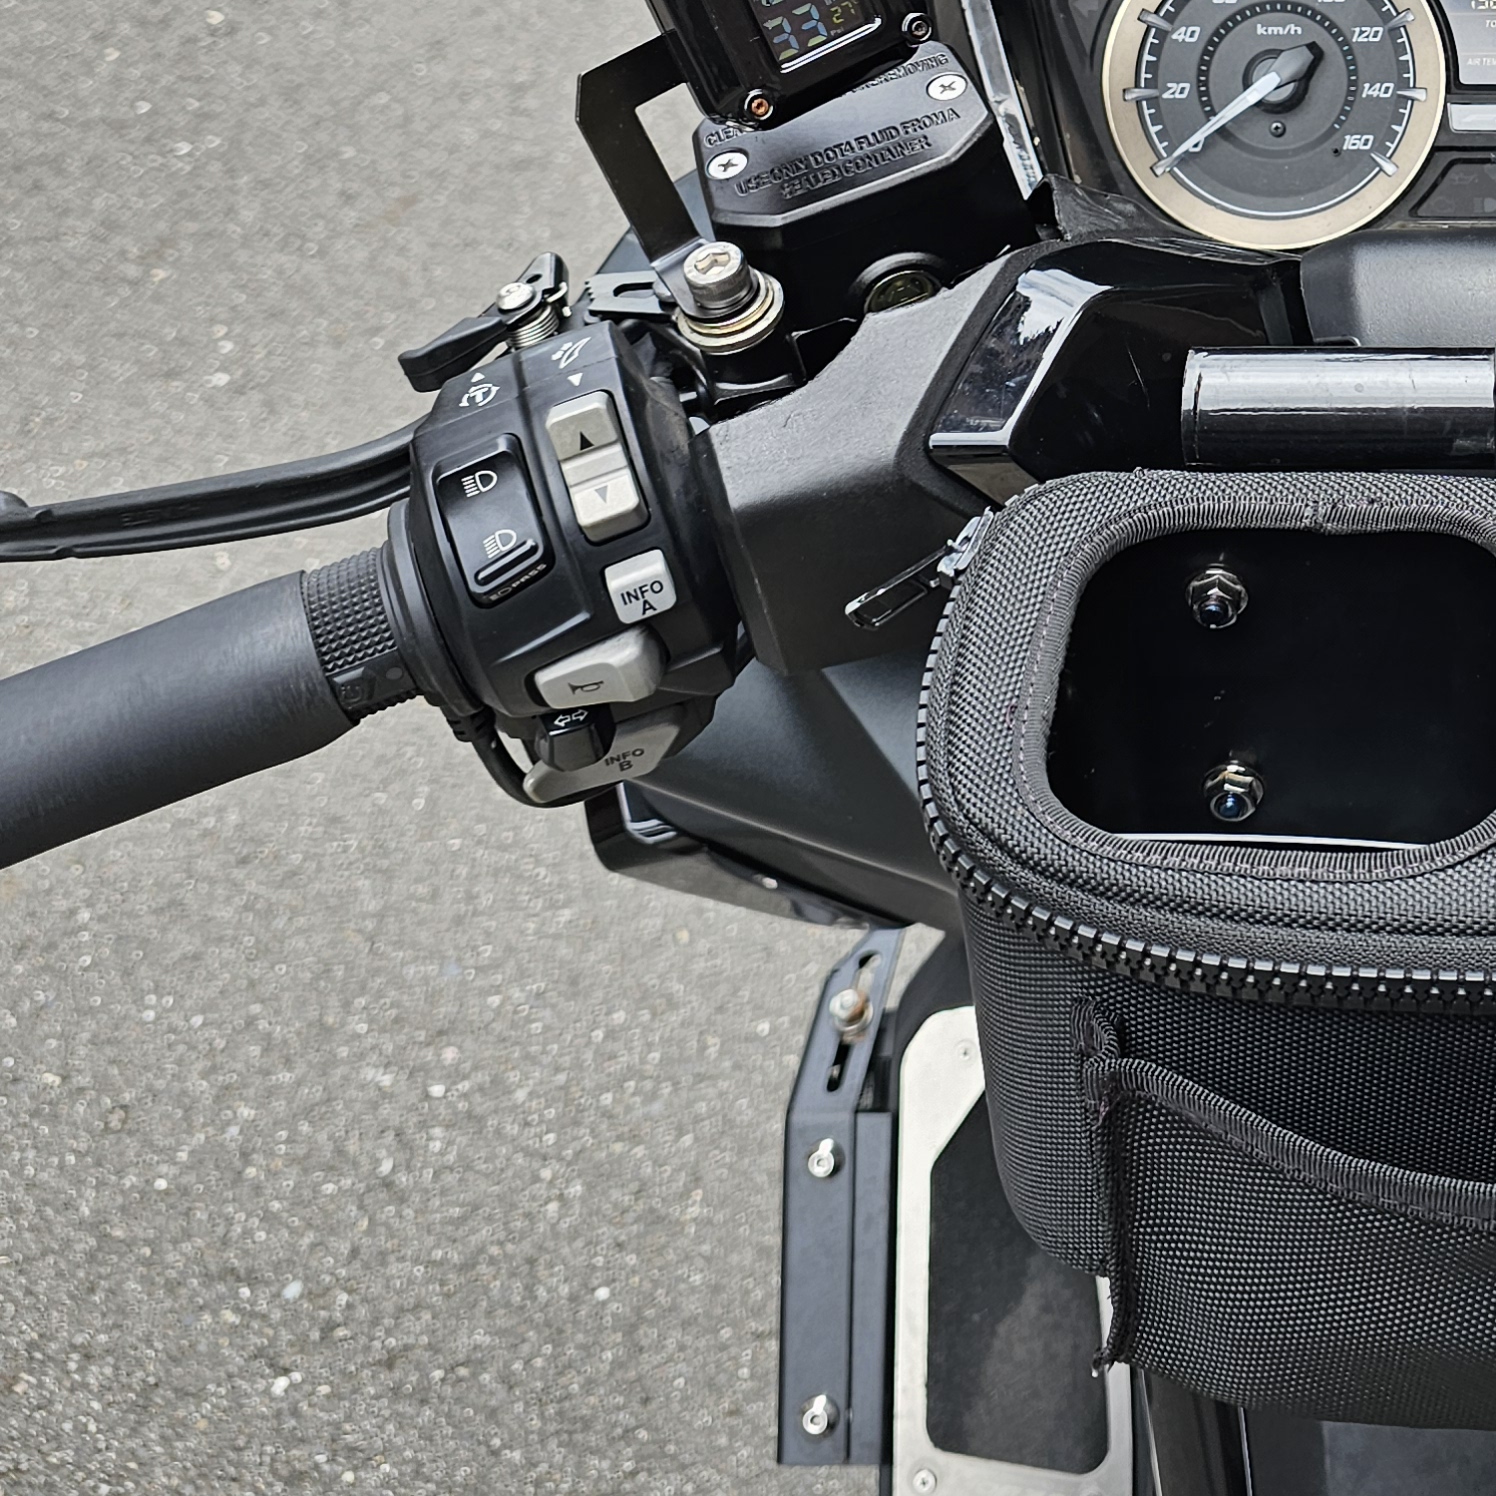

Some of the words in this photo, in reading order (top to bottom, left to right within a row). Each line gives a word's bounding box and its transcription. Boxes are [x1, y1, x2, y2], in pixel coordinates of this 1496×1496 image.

[763, 3, 828, 61] 33
[1171, 26, 1200, 42] 40
[1256, 24, 1302, 35] km/h
[1352, 27, 1383, 42] 120
[1467, 58, 1481, 66] AIR
[1162, 83, 1190, 98] 20
[1362, 83, 1394, 98] 140
[704, 126, 745, 148] CLEA
[1343, 135, 1374, 150] 160
[734, 171, 772, 197] USE
[769, 155, 809, 184] ONLY
[853, 125, 900, 151] FLUID
[781, 164, 842, 199] SEALED
[840, 134, 933, 177] CONTAINER
[512, 563, 547, 588] PASS
[620, 580, 664, 606] INFO
[642, 600, 657, 615] A
[604, 748, 645, 767] INFO
[619, 760, 633, 772] B
